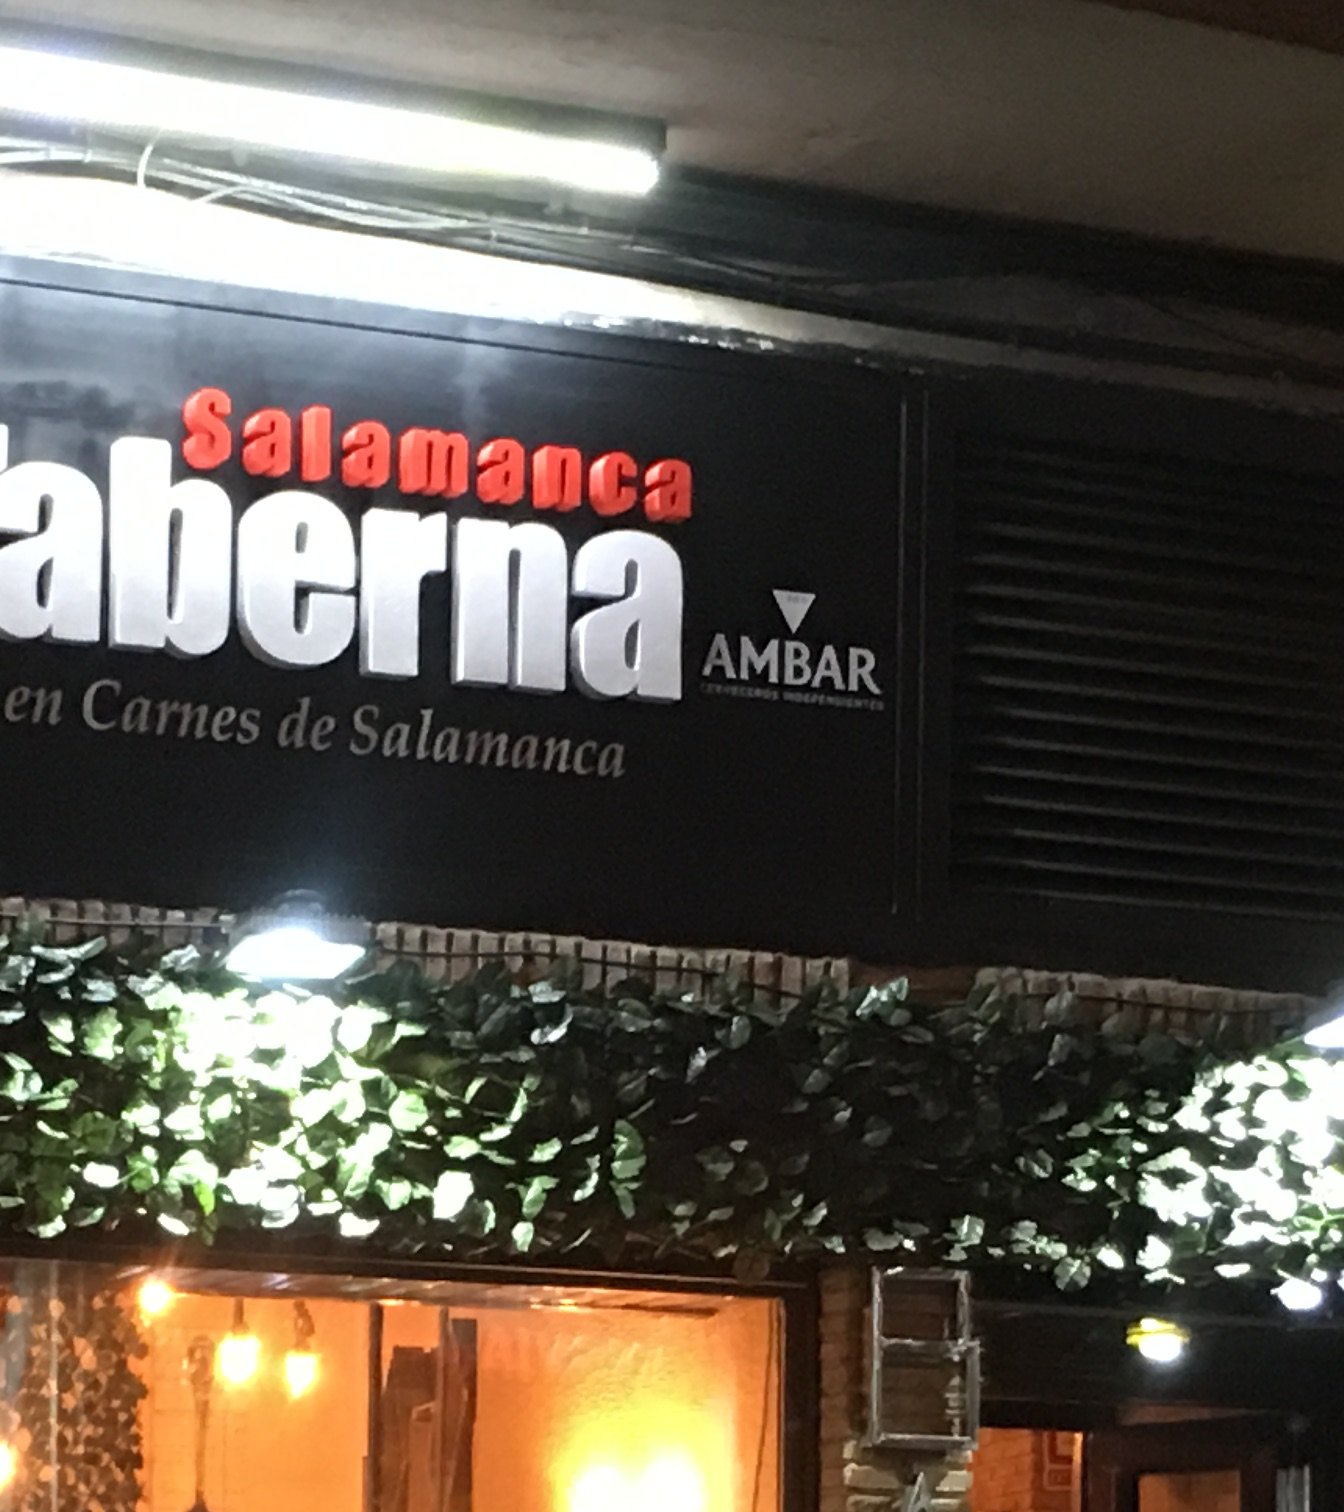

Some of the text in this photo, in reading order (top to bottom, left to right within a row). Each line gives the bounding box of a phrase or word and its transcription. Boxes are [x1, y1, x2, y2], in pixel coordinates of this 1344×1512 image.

[181, 387, 693, 523] Salamanca
[702, 633, 883, 695] AMBAR
[4, 683, 63, 724] en
[82, 679, 261, 746] Carnes
[277, 697, 337, 752] de
[349, 704, 627, 778] Salamanca
